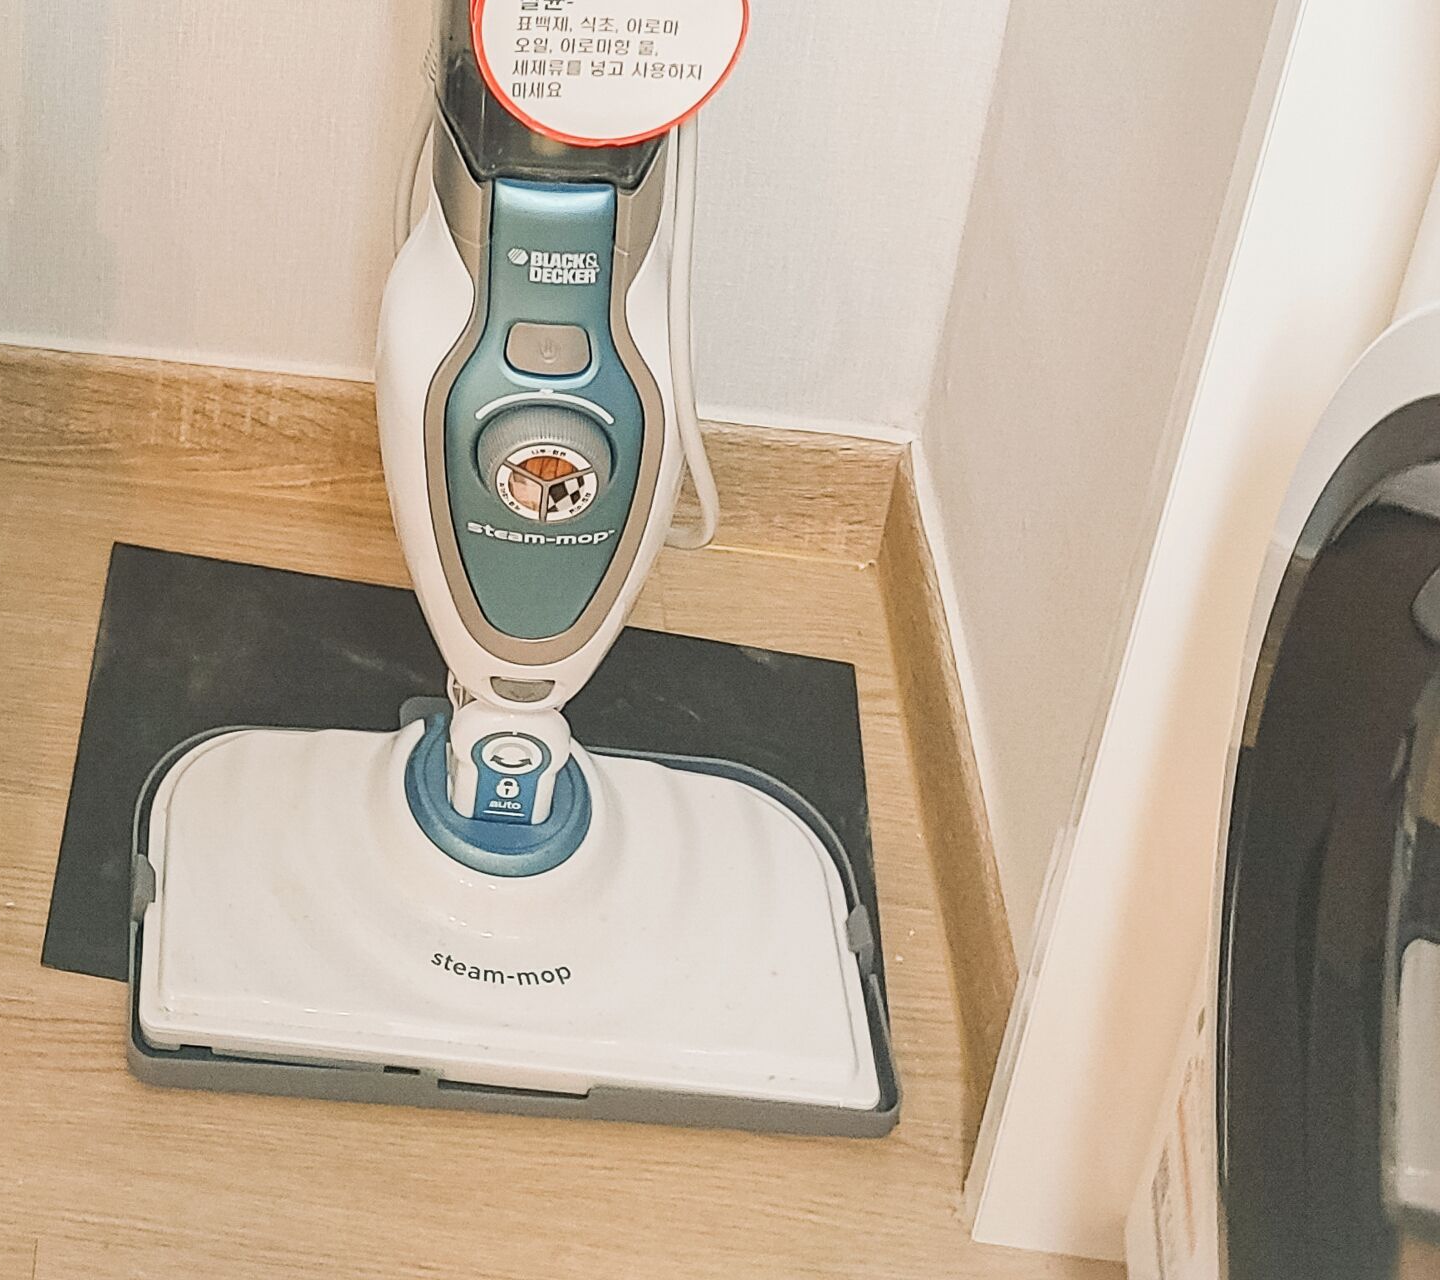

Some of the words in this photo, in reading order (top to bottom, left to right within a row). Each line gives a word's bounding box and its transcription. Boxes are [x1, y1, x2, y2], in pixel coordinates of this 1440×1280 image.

[516, 15, 573, 33] 표백제,
[580, 16, 619, 34] 식초,
[513, 37, 553, 54] 오일,
[511, 81, 563, 100] 마세요
[530, 250, 600, 268] BLACK&
[529, 266, 597, 284] DECKER
[466, 521, 610, 545] steam-mop
[488, 800, 522, 810] auto
[430, 951, 572, 986] steam-mop
